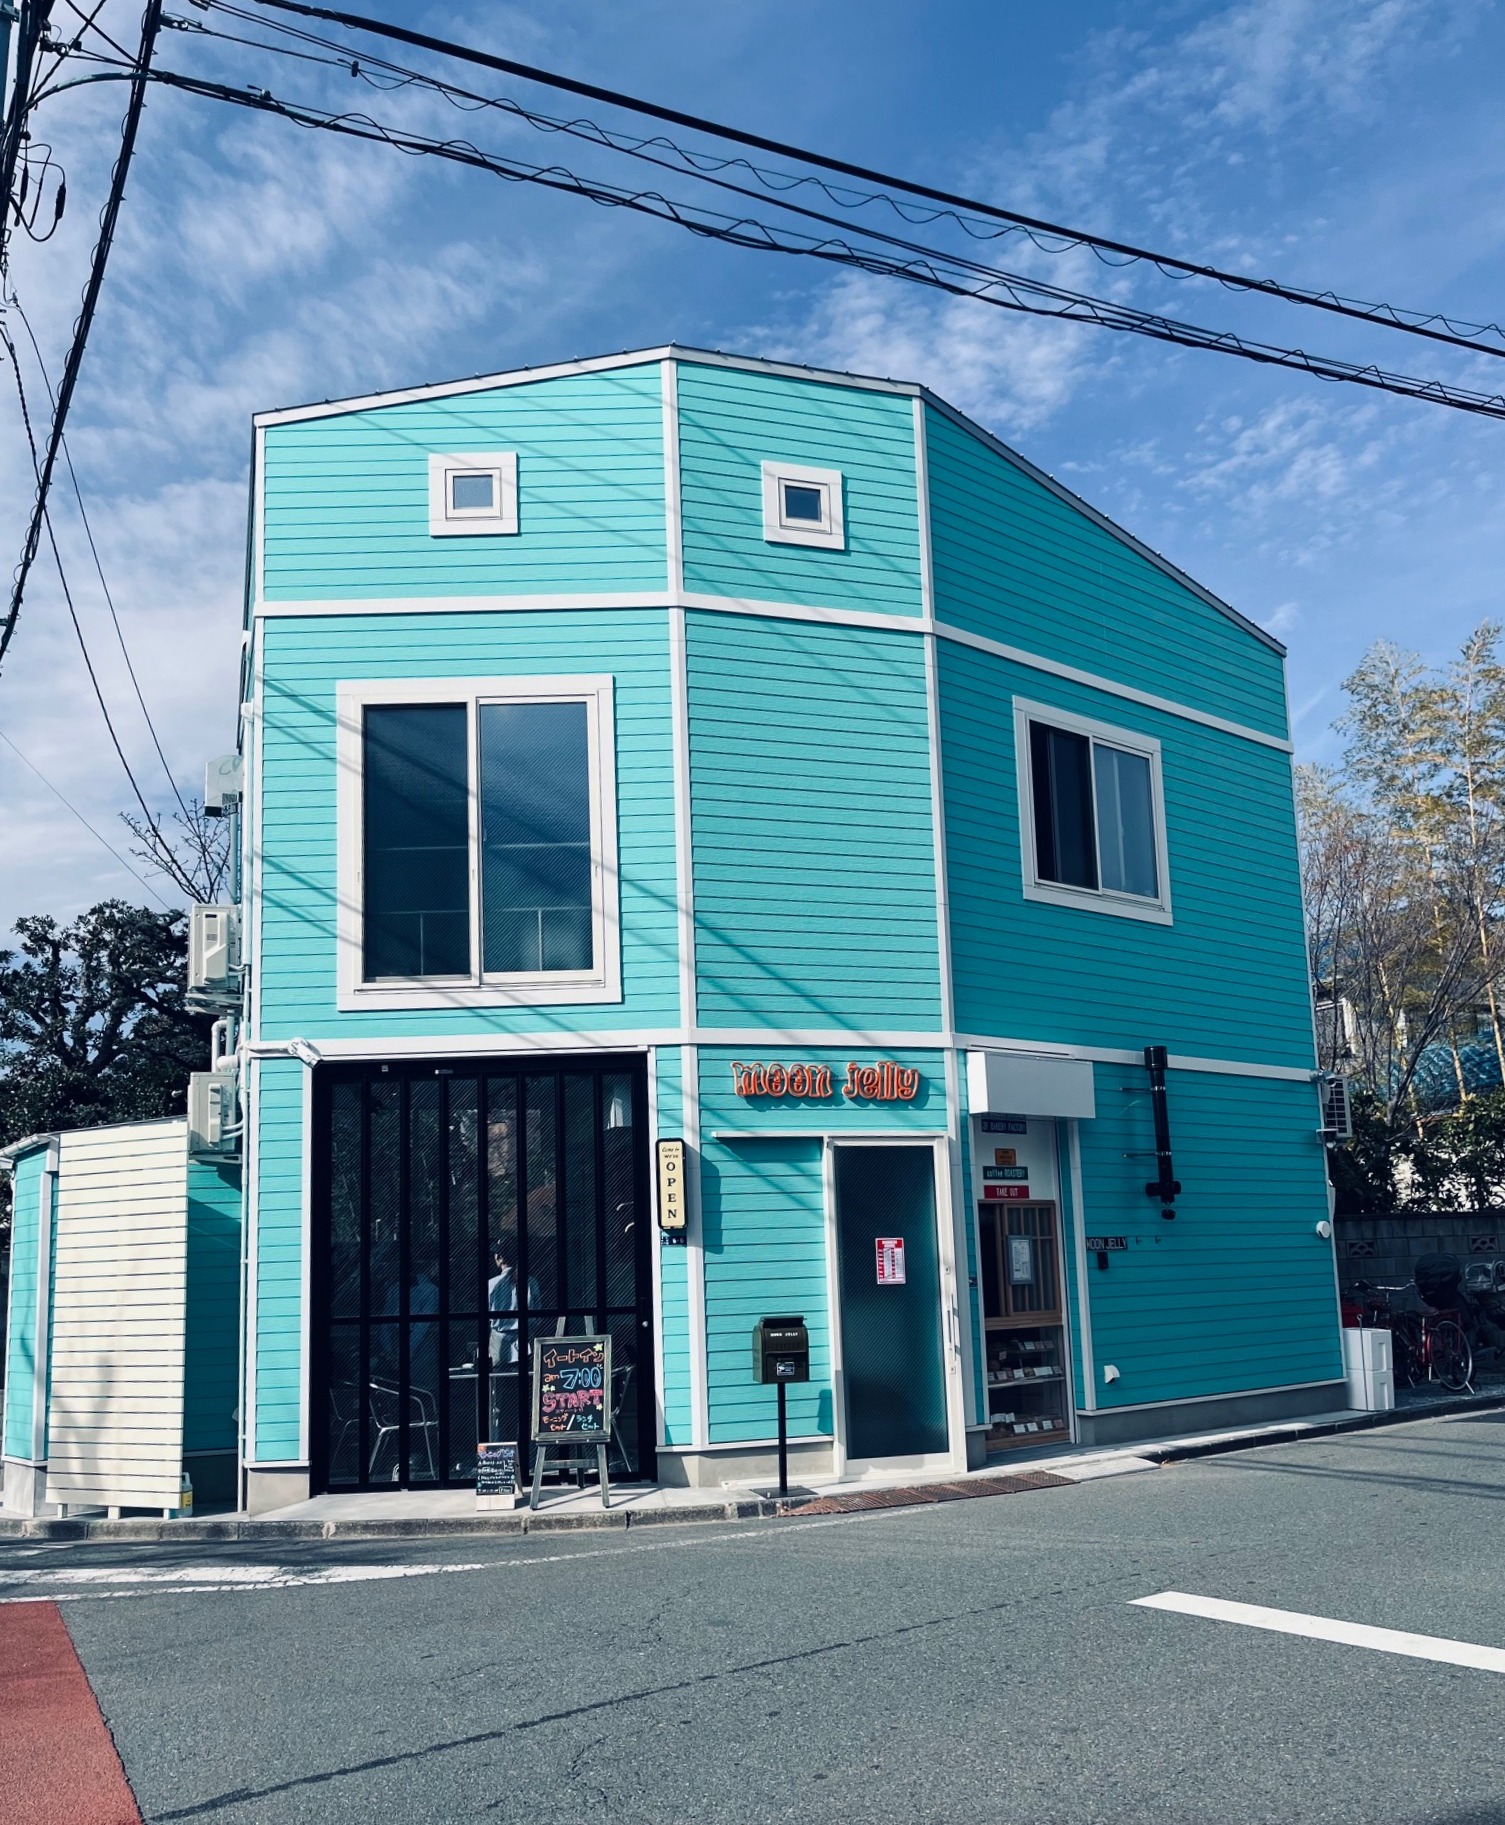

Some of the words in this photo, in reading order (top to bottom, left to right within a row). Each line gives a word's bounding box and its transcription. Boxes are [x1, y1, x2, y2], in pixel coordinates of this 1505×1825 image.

[730, 1060, 833, 1099] moon
[842, 1060, 919, 1100] jelly
[666, 1161, 678, 1219] OPEN
[996, 1187, 1008, 1197] TAKE
[1009, 1187, 1019, 1197] OUT
[1106, 1238, 1127, 1250] JELLY
[544, 1349, 604, 1368] イートイン
[544, 1373, 559, 1382] am
[560, 1366, 602, 1389] 7:00
[542, 1389, 603, 1412] START
[576, 1414, 594, 1423] ランチ
